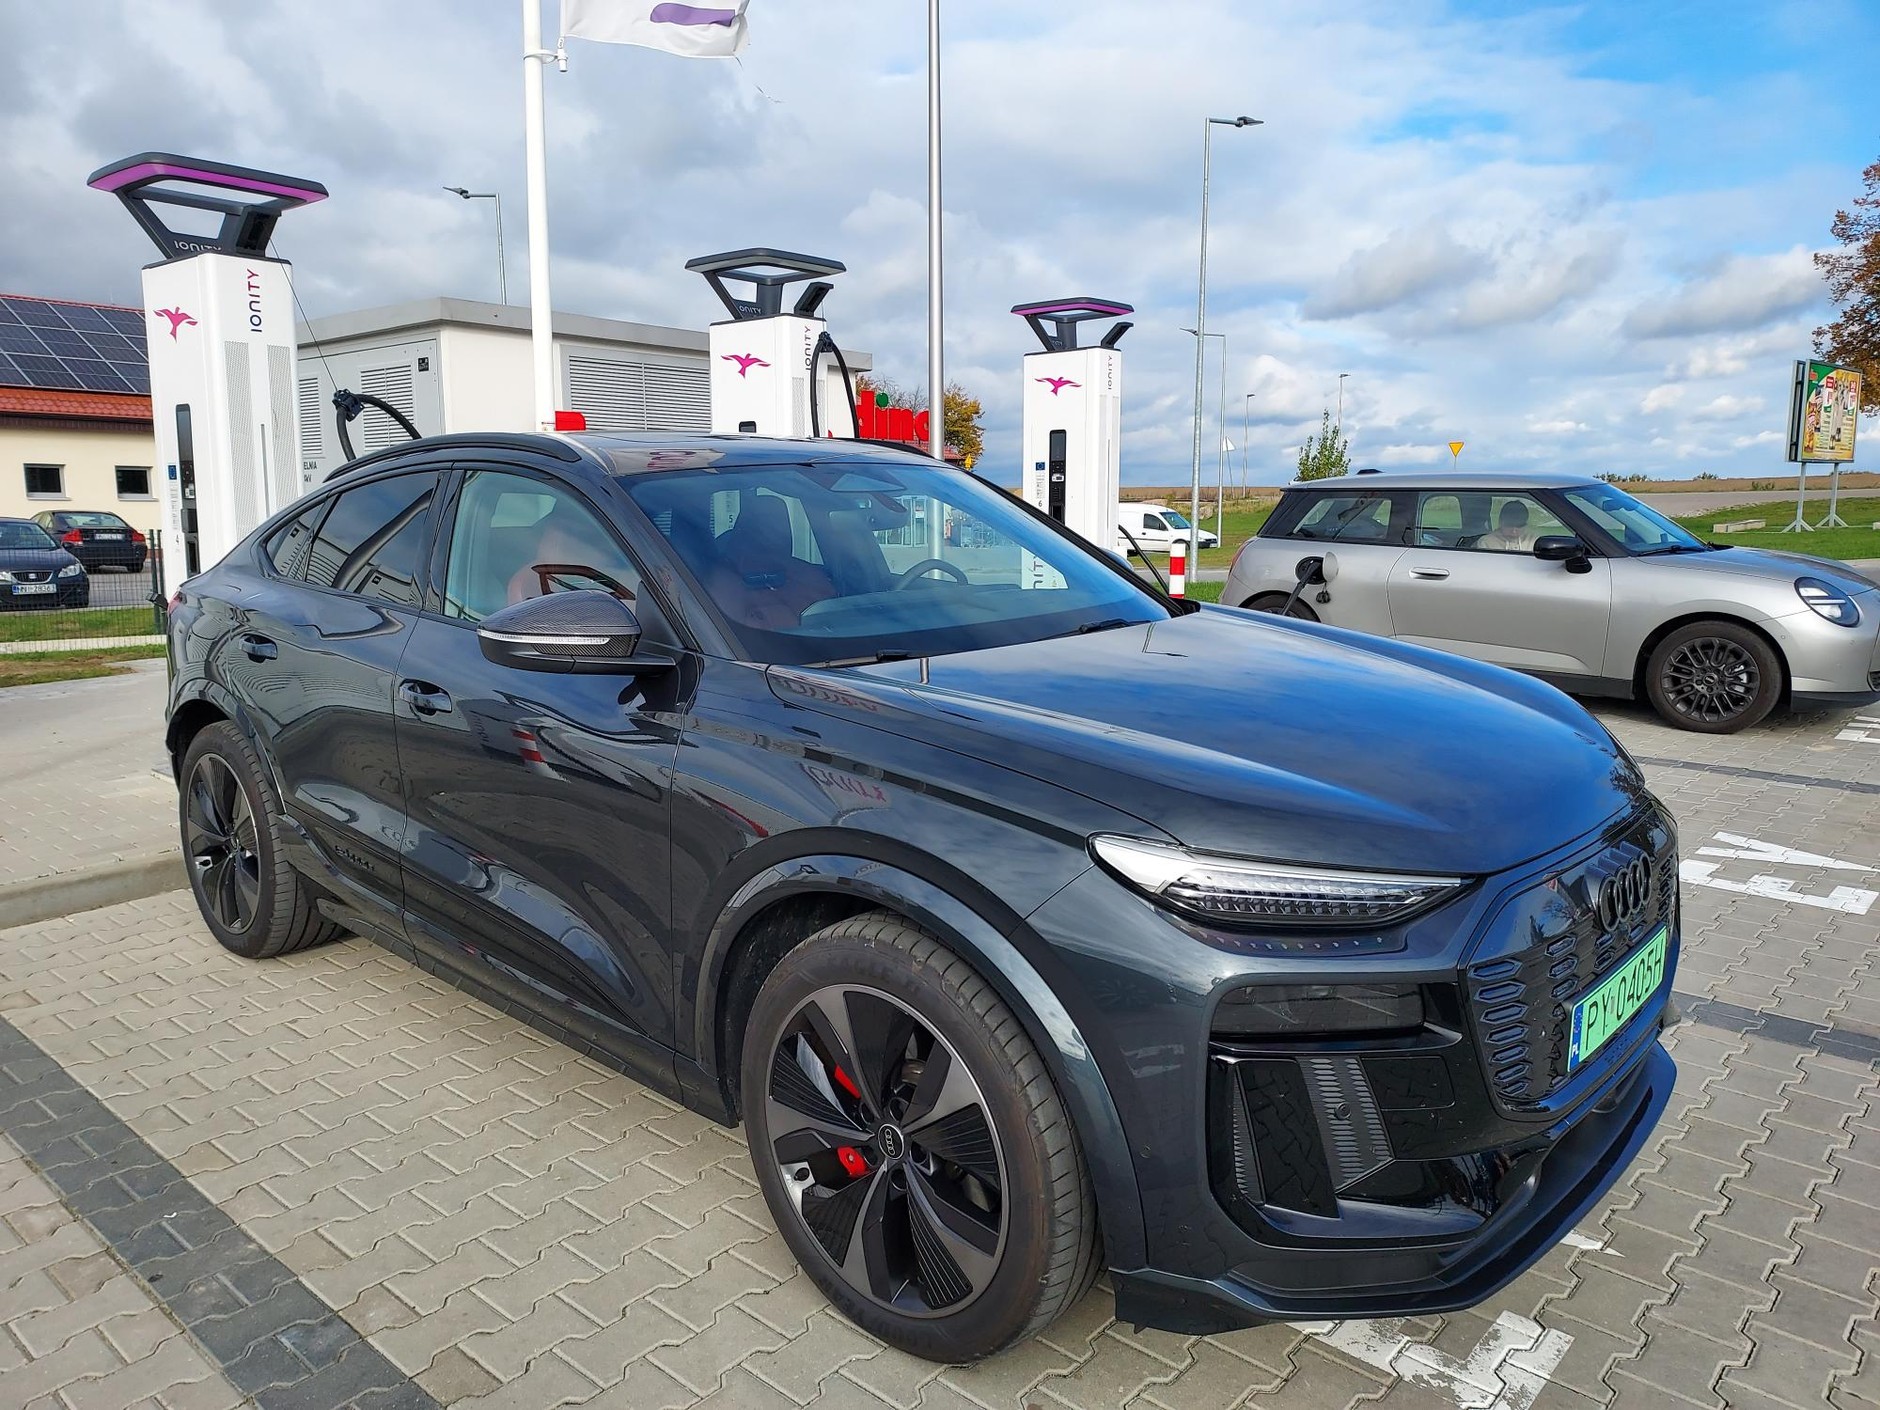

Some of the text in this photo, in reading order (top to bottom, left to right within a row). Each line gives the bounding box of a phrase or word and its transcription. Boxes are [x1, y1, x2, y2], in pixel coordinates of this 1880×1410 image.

[246, 268, 263, 333] IONITY
[1585, 937, 1664, 1051] PY 0405H
